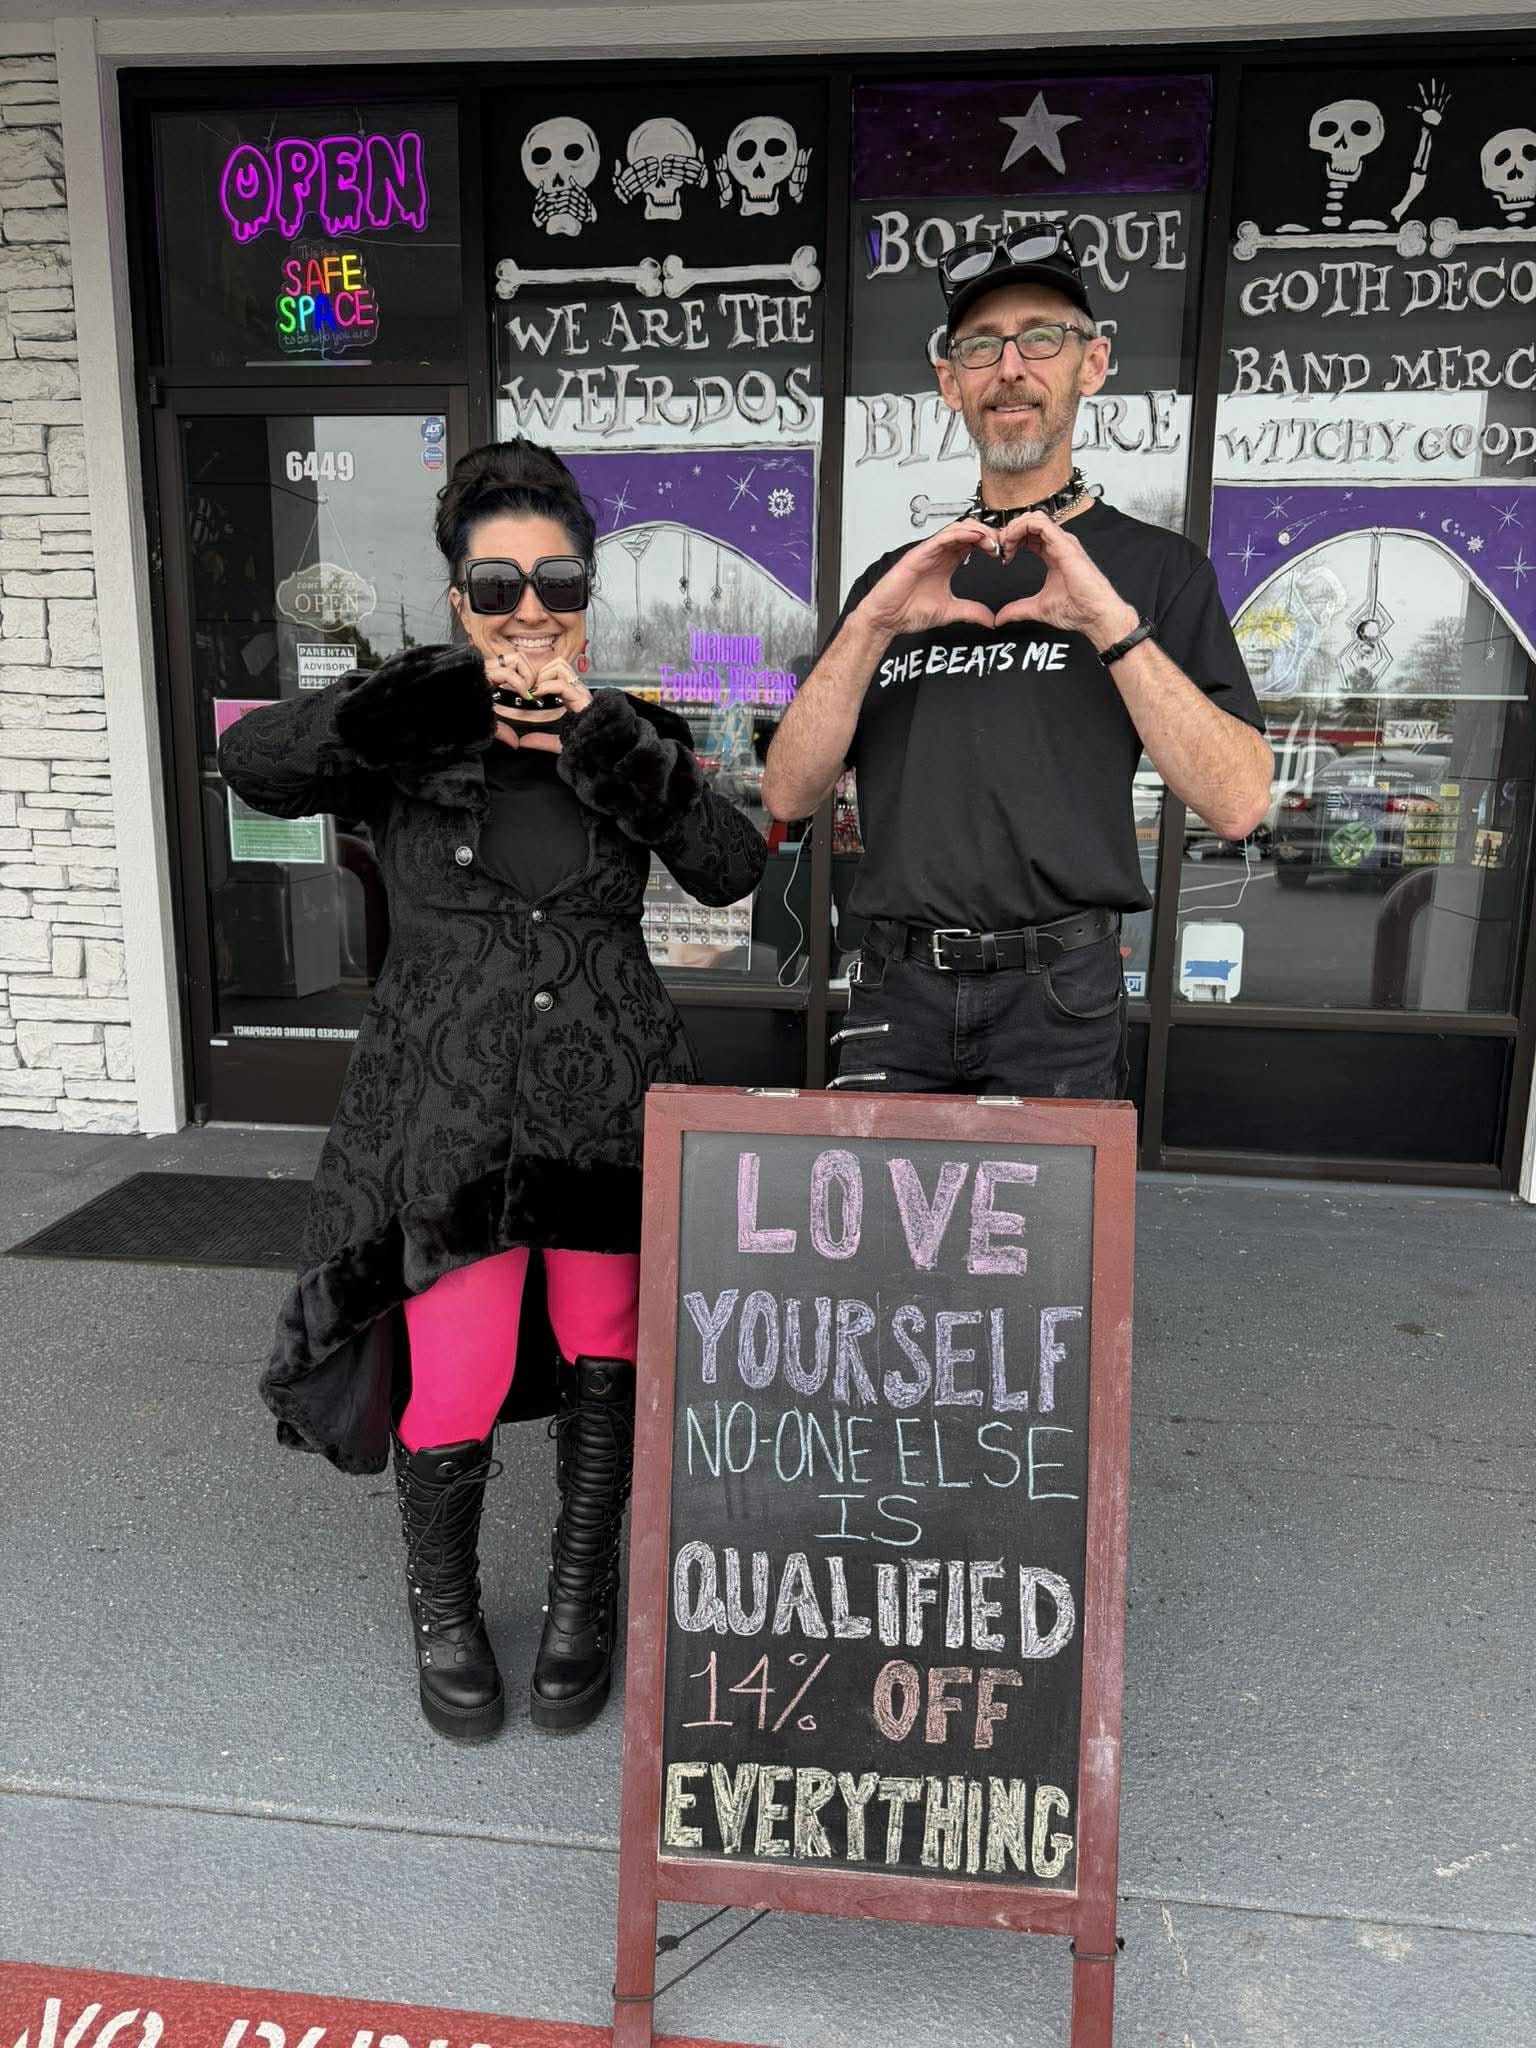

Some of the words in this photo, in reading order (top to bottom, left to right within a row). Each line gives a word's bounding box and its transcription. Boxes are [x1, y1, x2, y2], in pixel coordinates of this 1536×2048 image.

[221, 132, 427, 241] OPEN
[284, 254, 362, 297] SAFE
[866, 209, 1187, 293] BOQUE
[279, 290, 375, 333] SPACE
[1240, 261, 1394, 317] GOTH
[1400, 257, 1536, 317] DECO
[505, 302, 590, 356] WE
[601, 299, 710, 352] ARE
[718, 293, 815, 350] THE
[501, 364, 816, 438] WEIRDOS
[1224, 347, 1371, 403] BAND
[855, 389, 1182, 467] BIZRE
[1217, 418, 1416, 465] WITCHY
[286, 451, 354, 482] 6449
[295, 593, 360, 613] OPEN
[300, 647, 354, 657] PARENTAL
[304, 662, 351, 671] ADVISORY
[1022, 641, 1070, 672] ME
[736, 1150, 1039, 1276] LOVE
[683, 1288, 1084, 1413] YOURSELF
[687, 1400, 873, 1482] NO-ONE
[896, 1418, 1080, 1500] ELSE
[814, 1494, 923, 1546] IS
[673, 1540, 1076, 1659] QUALIFIED
[682, 1650, 832, 1733] 14%
[872, 1659, 1024, 1750] OFF
[664, 1761, 1074, 1878] EVERYTHING
